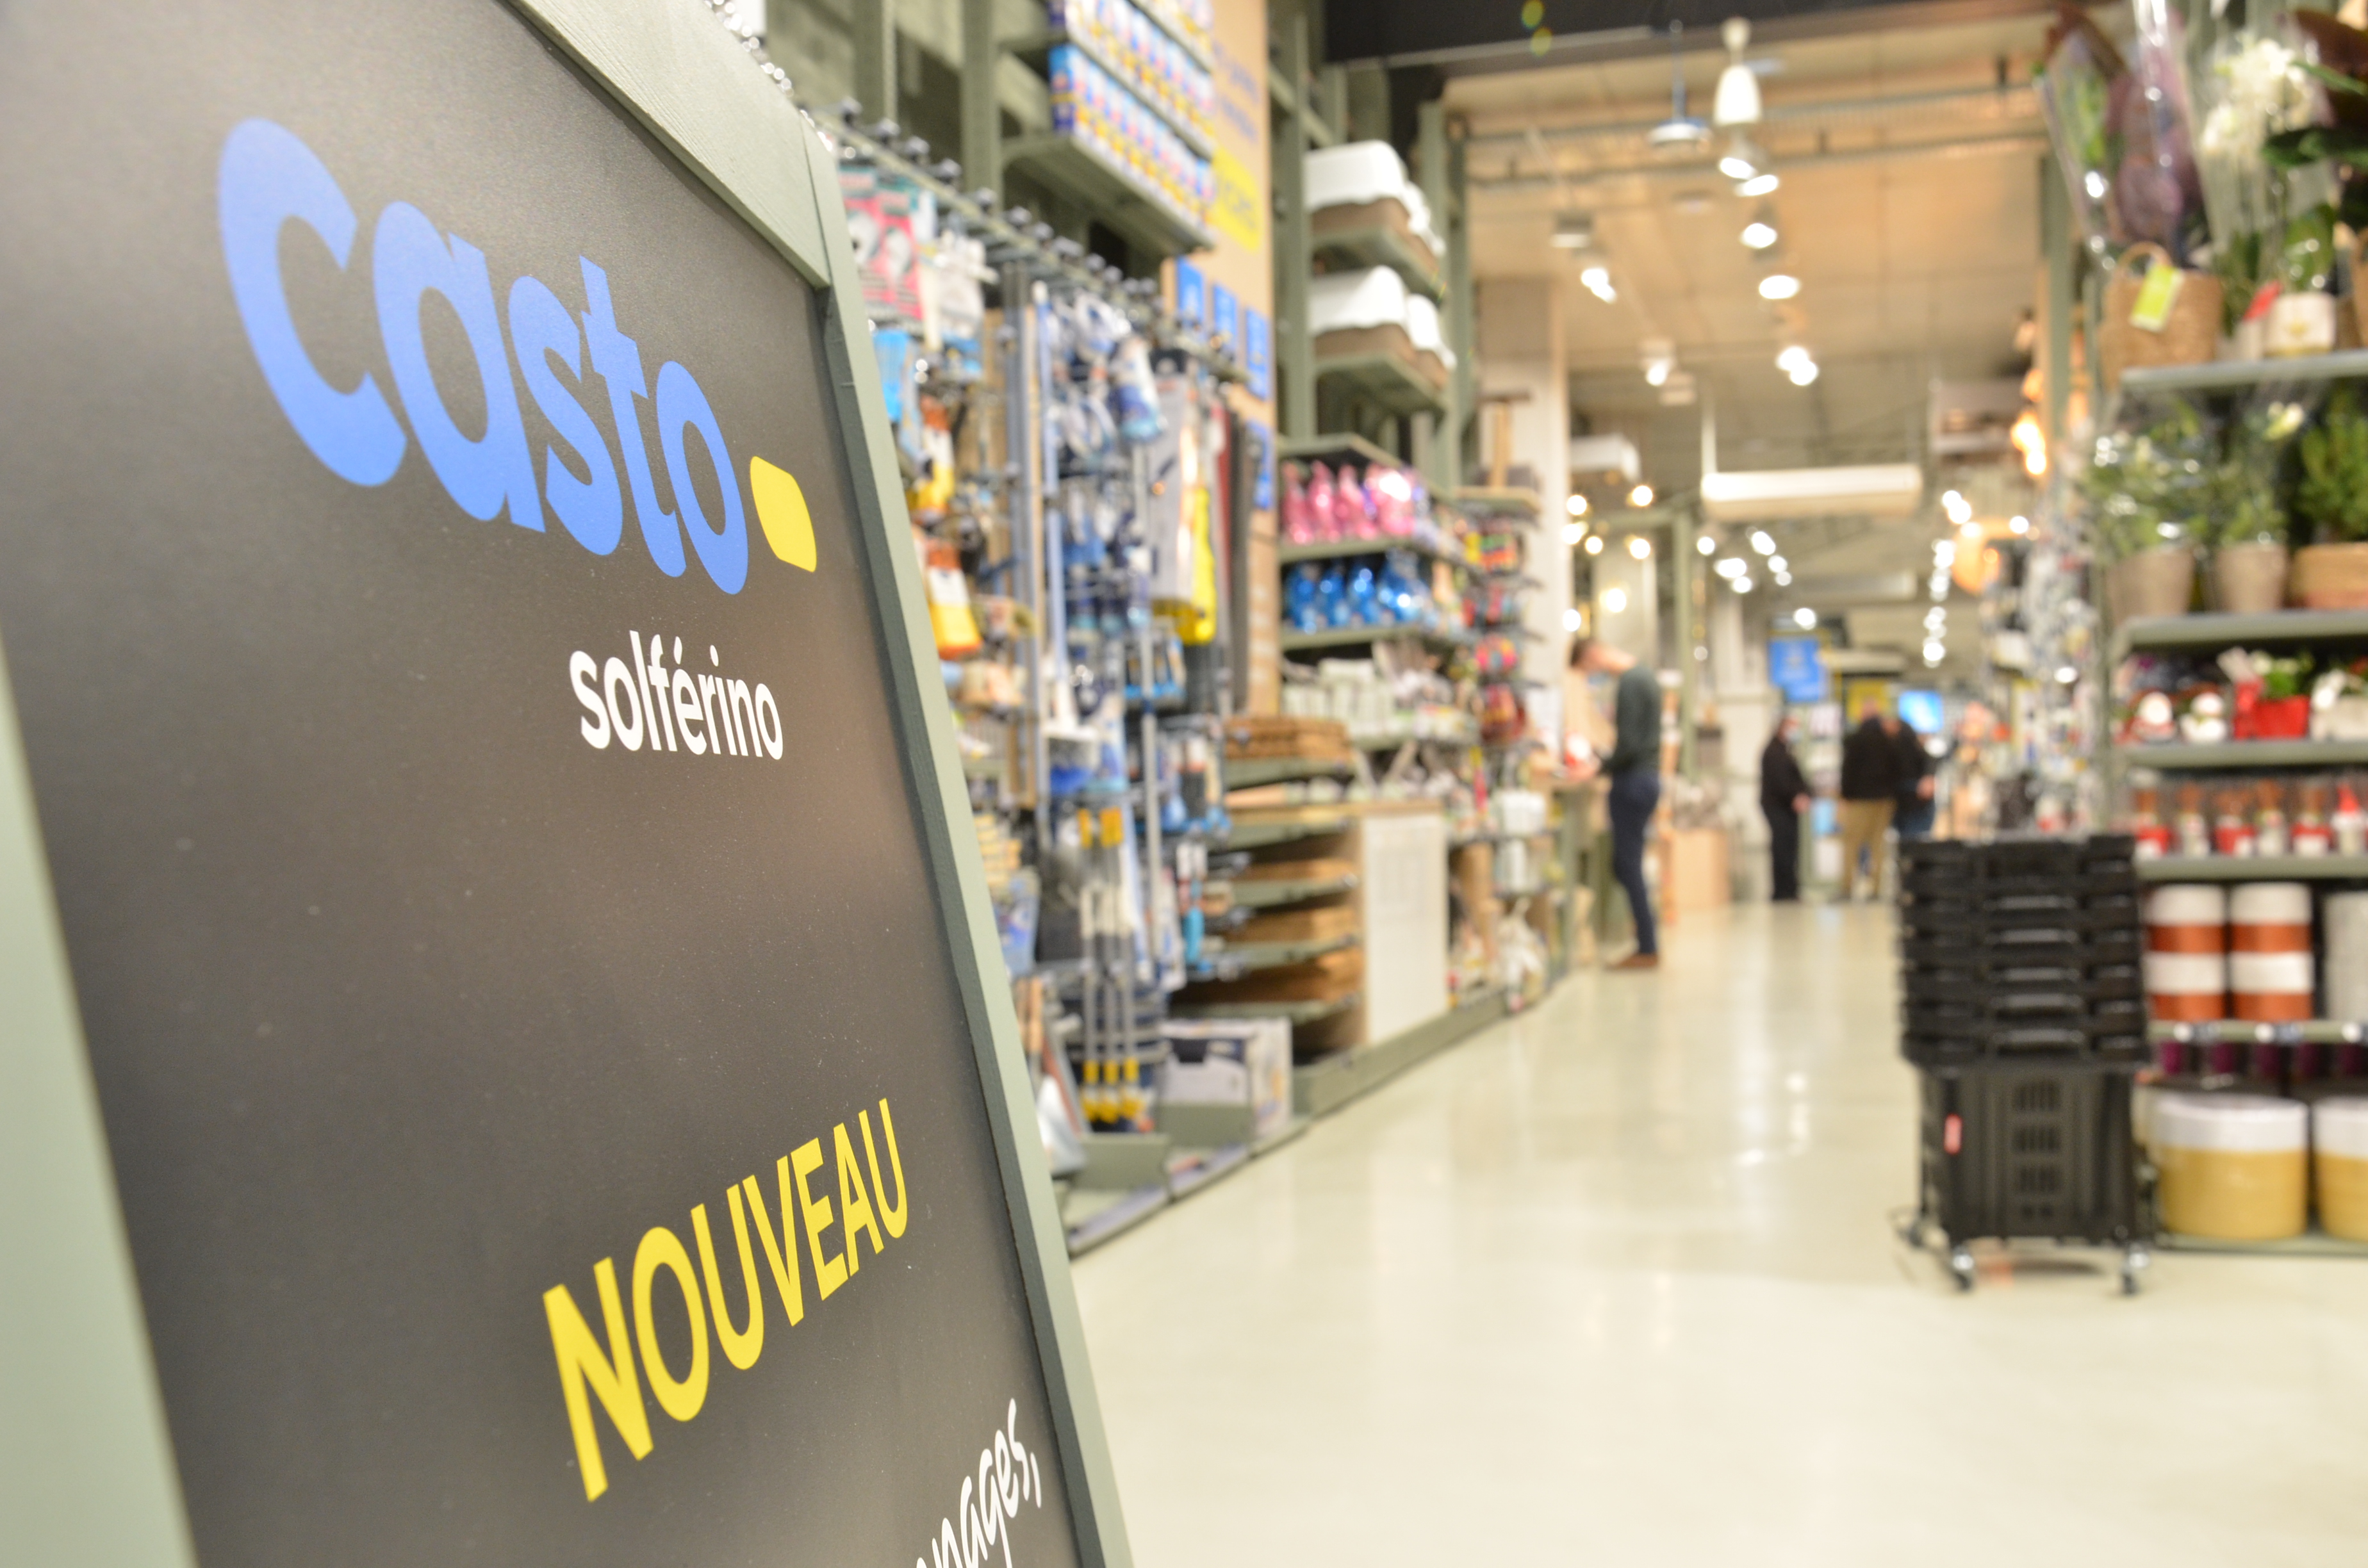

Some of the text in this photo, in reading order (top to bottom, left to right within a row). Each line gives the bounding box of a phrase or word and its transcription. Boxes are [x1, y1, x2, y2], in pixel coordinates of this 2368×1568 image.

[218, 118, 748, 594] casto
[569, 629, 784, 760] solférino
[543, 1097, 909, 1503] NOUVEAU
[916, 1398, 1042, 1568] nages,
